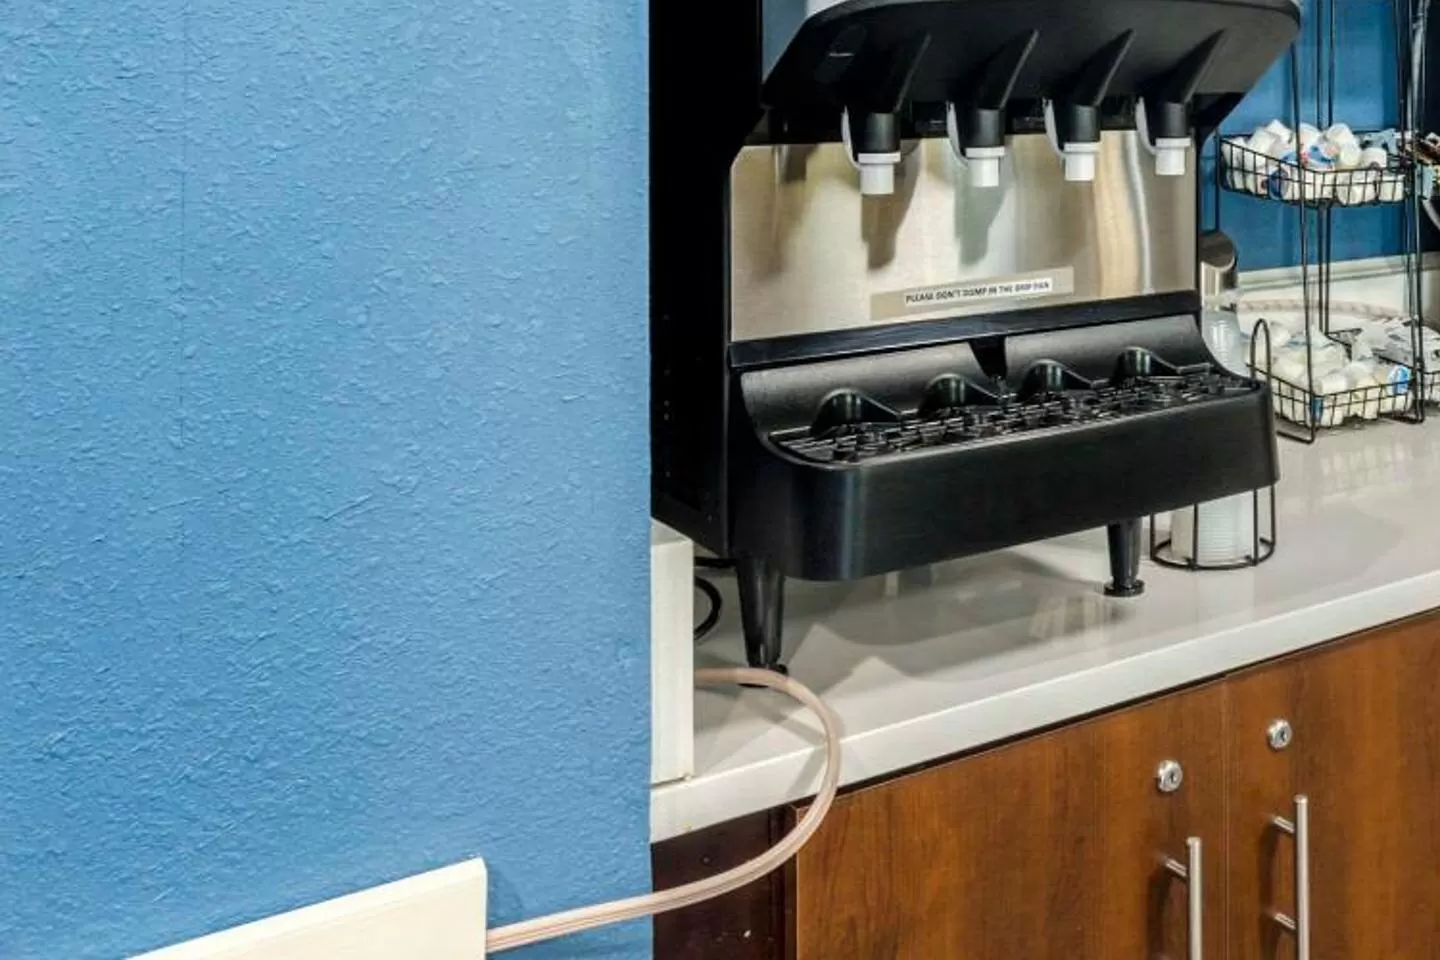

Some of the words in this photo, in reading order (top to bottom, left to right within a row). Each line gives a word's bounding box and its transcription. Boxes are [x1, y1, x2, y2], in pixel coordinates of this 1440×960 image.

[905, 292, 934, 303] PLEASE
[936, 289, 961, 300] DON'T
[962, 287, 986, 297] DUMP
[999, 284, 1013, 294] THE
